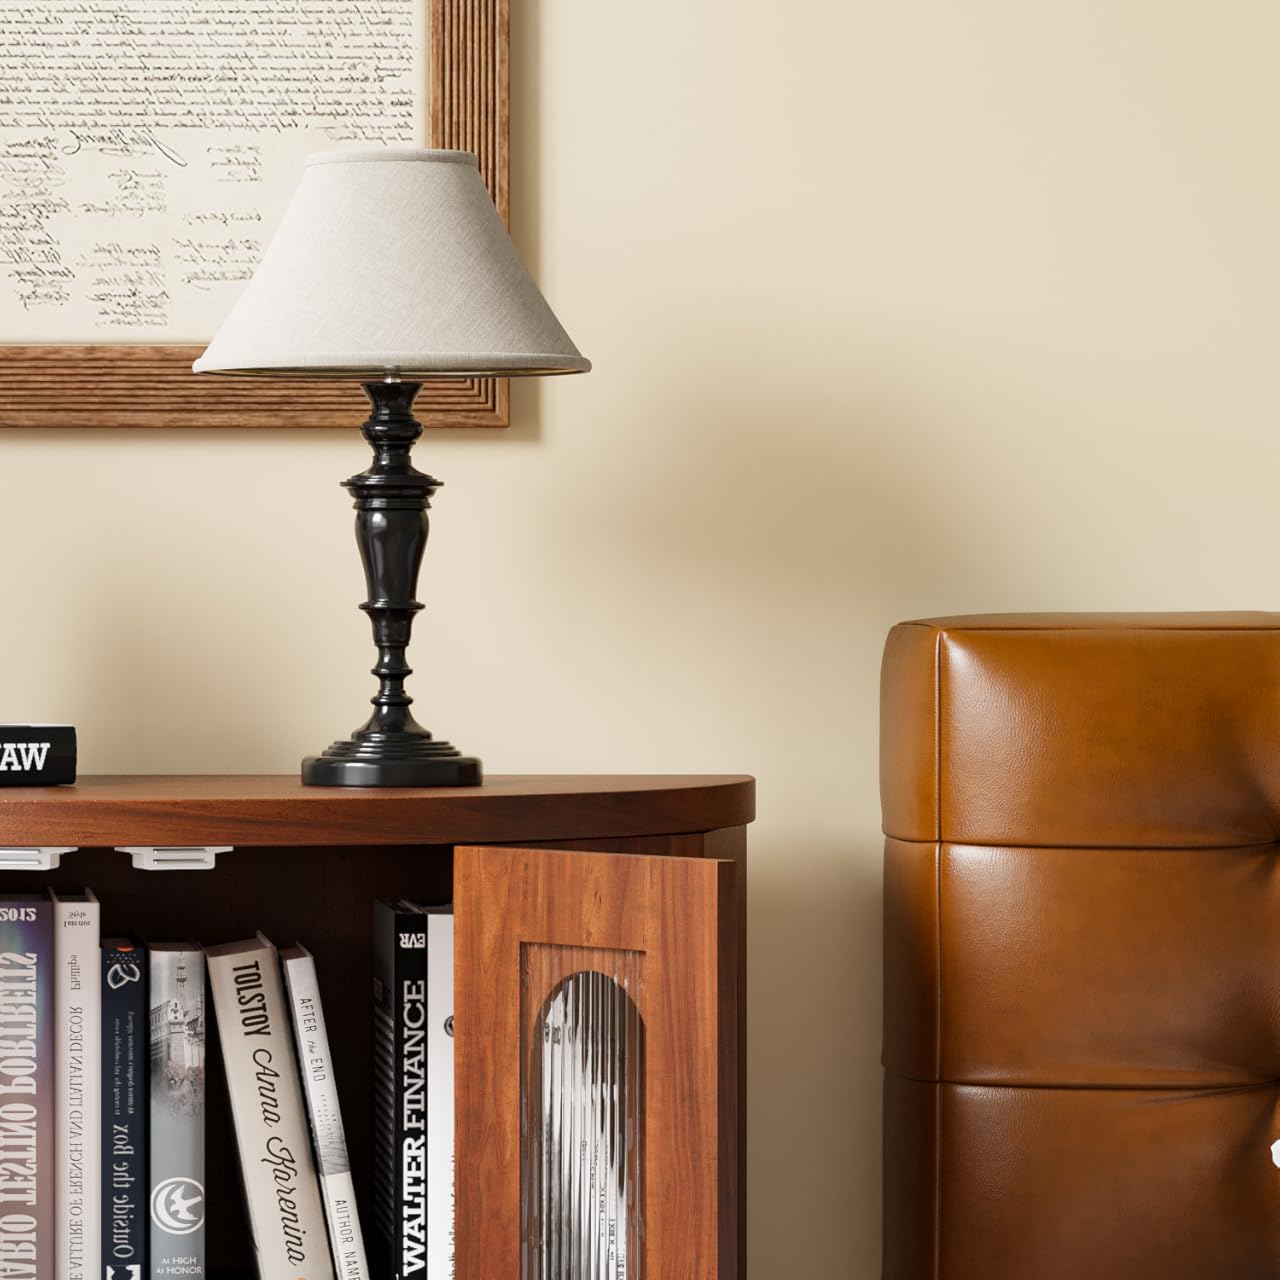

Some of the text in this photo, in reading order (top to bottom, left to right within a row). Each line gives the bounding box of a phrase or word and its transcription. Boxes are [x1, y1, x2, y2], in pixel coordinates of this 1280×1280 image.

[399, 933, 426, 948] EVR
[300, 997, 317, 1034] AFTER
[310, 1057, 326, 1082] END
[232, 960, 306, 1267] TOLSTOY Anna Karenina
[403, 980, 426, 1277] WALTER FINANCE
[334, 1199, 354, 1245] AUTHOR
[166, 1266, 202, 1274] HONOR
[172, 1256, 197, 1264] HIGH
